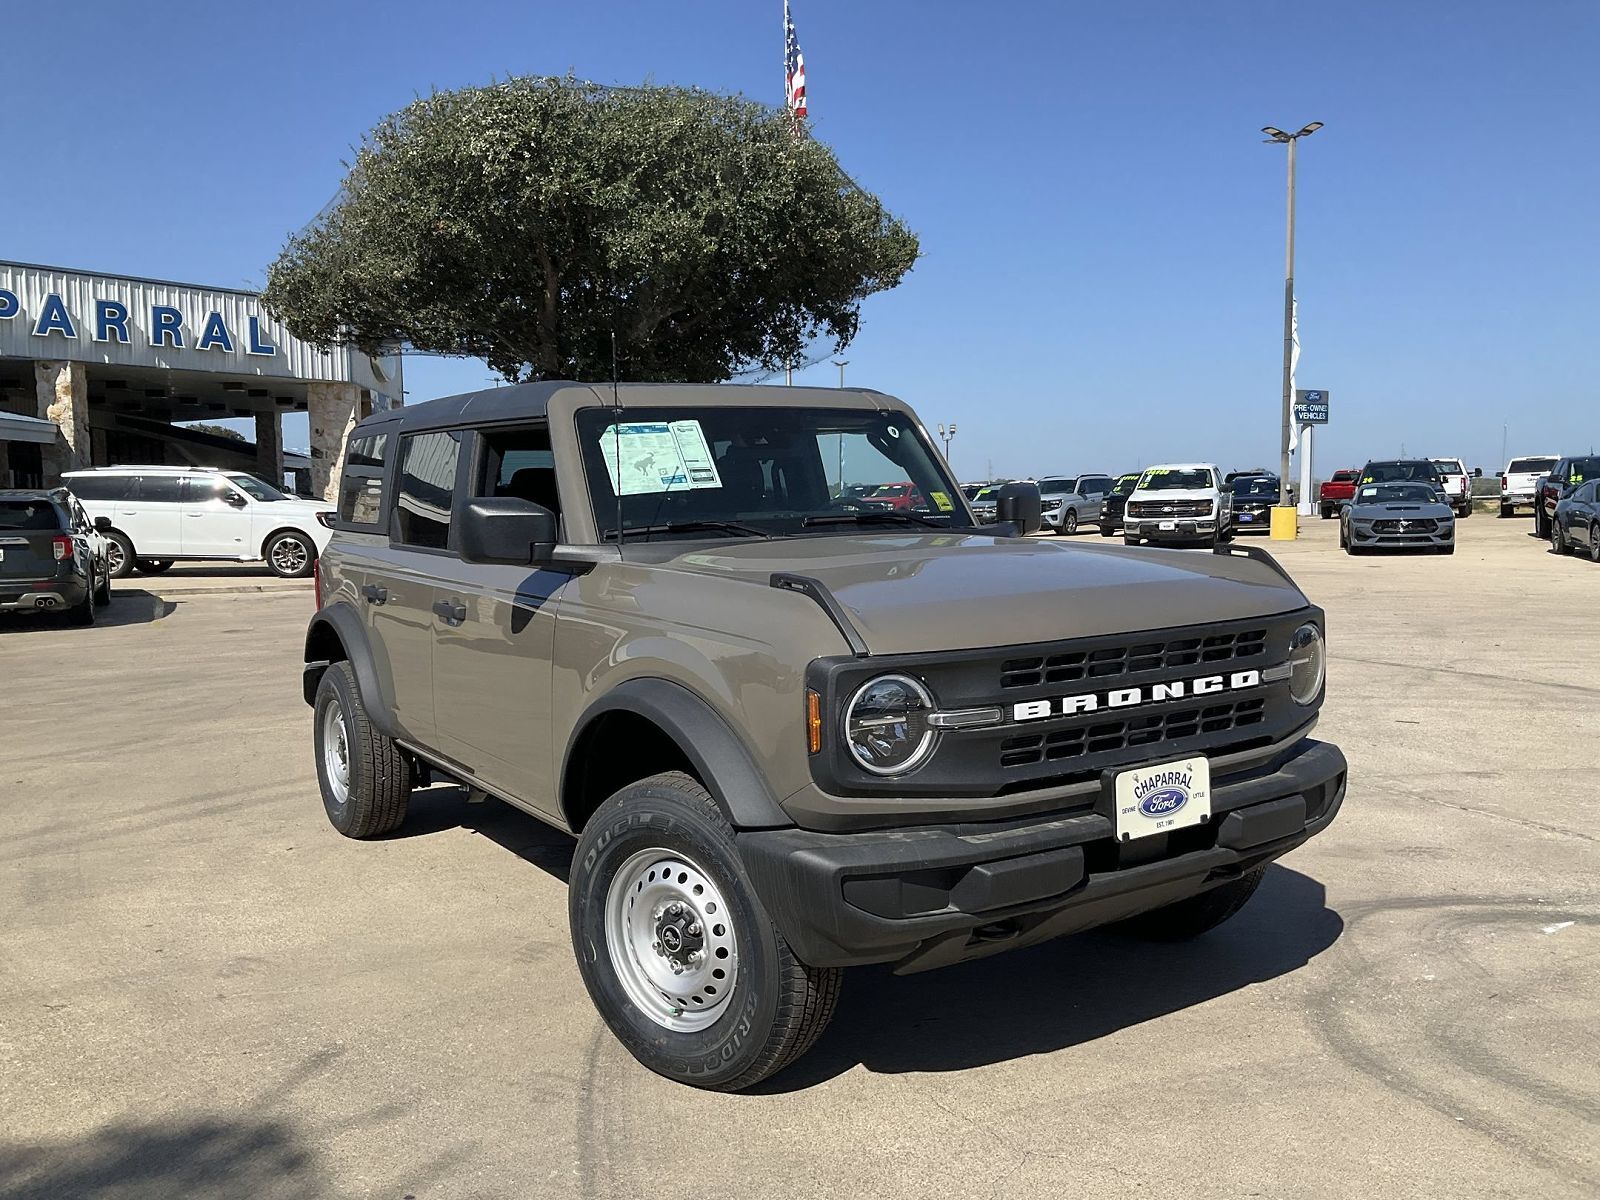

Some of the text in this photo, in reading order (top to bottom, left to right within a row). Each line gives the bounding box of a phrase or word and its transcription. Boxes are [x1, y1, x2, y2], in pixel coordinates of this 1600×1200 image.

[1013, 670, 1259, 721] BRONCO
[1134, 772, 1192, 799] CHAPARRAL
[1193, 791, 1204, 799] LYTLE
[1122, 806, 1136, 814] DEVINE
[1150, 793, 1177, 813] Ford
